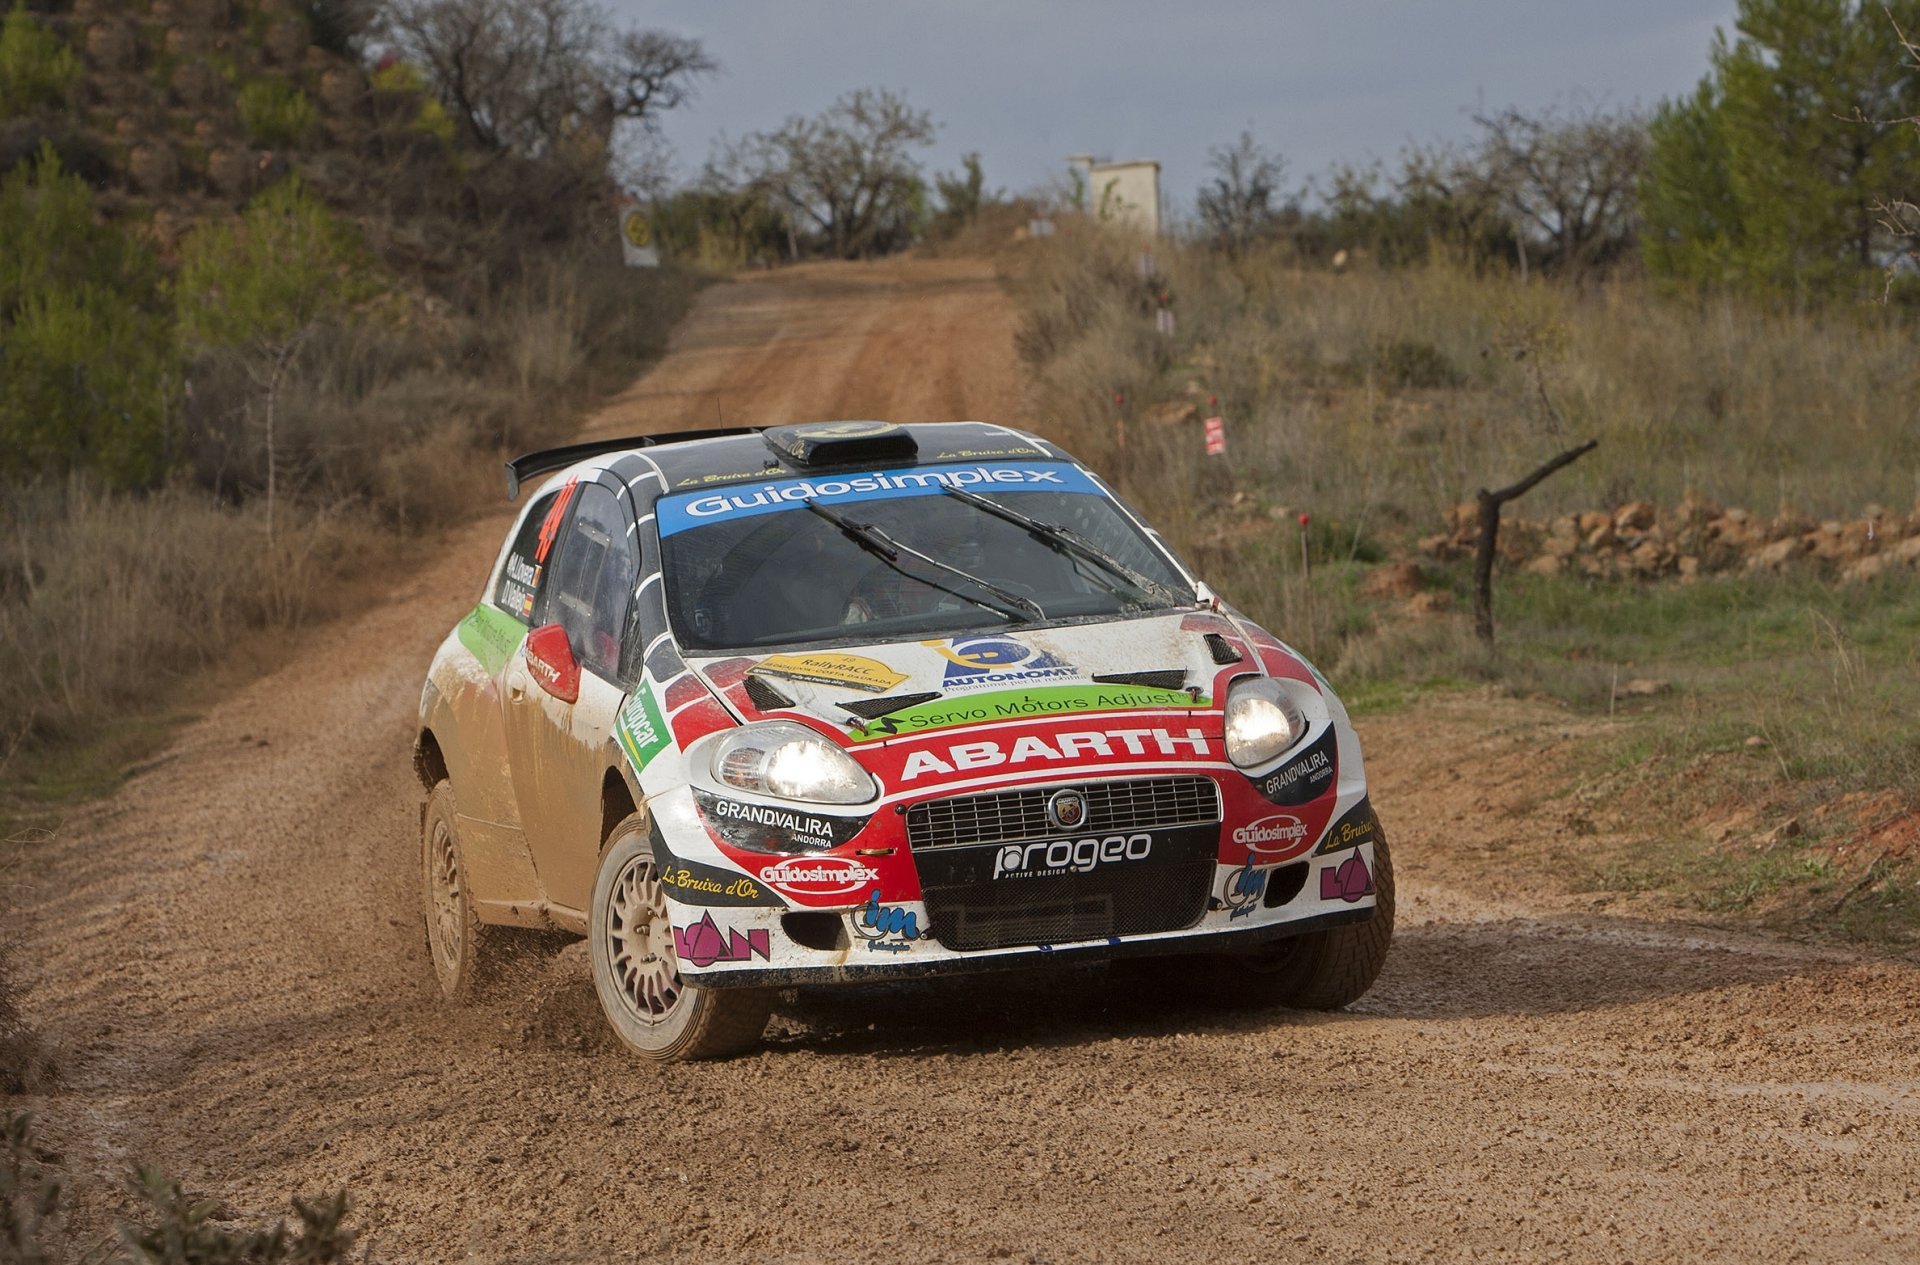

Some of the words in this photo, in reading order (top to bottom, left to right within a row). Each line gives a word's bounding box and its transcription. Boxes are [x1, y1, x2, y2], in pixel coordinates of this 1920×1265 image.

[936, 451, 957, 459] La
[958, 449, 1005, 457] Bruixa
[676, 477, 693, 487] La
[703, 471, 751, 483] Bruixa
[685, 466, 1065, 517] Guidosimplex
[801, 658, 877, 675] RallyRACC
[846, 673, 892, 686] DAURADA
[942, 667, 1080, 688] AUTONOMY
[944, 681, 1007, 693] Programma
[908, 706, 986, 729] Servo
[994, 697, 1089, 717] Motors
[900, 728, 1211, 782] ABARTH
[1265, 750, 1330, 795] GRANDVALIRA
[1308, 765, 1335, 785] ANDORRA
[715, 799, 835, 839] GRANDVALIRA
[790, 832, 833, 850] ANDORRA
[1232, 822, 1309, 845] Guidosimplex
[1324, 829, 1341, 850] La
[992, 833, 1153, 881] progeo
[661, 864, 677, 886] La
[677, 869, 724, 895] Bruixa
[725, 877, 760, 900] d'Or
[758, 861, 880, 885] Guidosimplex
[1004, 870, 1034, 880] ACTIVE
[1036, 867, 1067, 878] DESIGN
